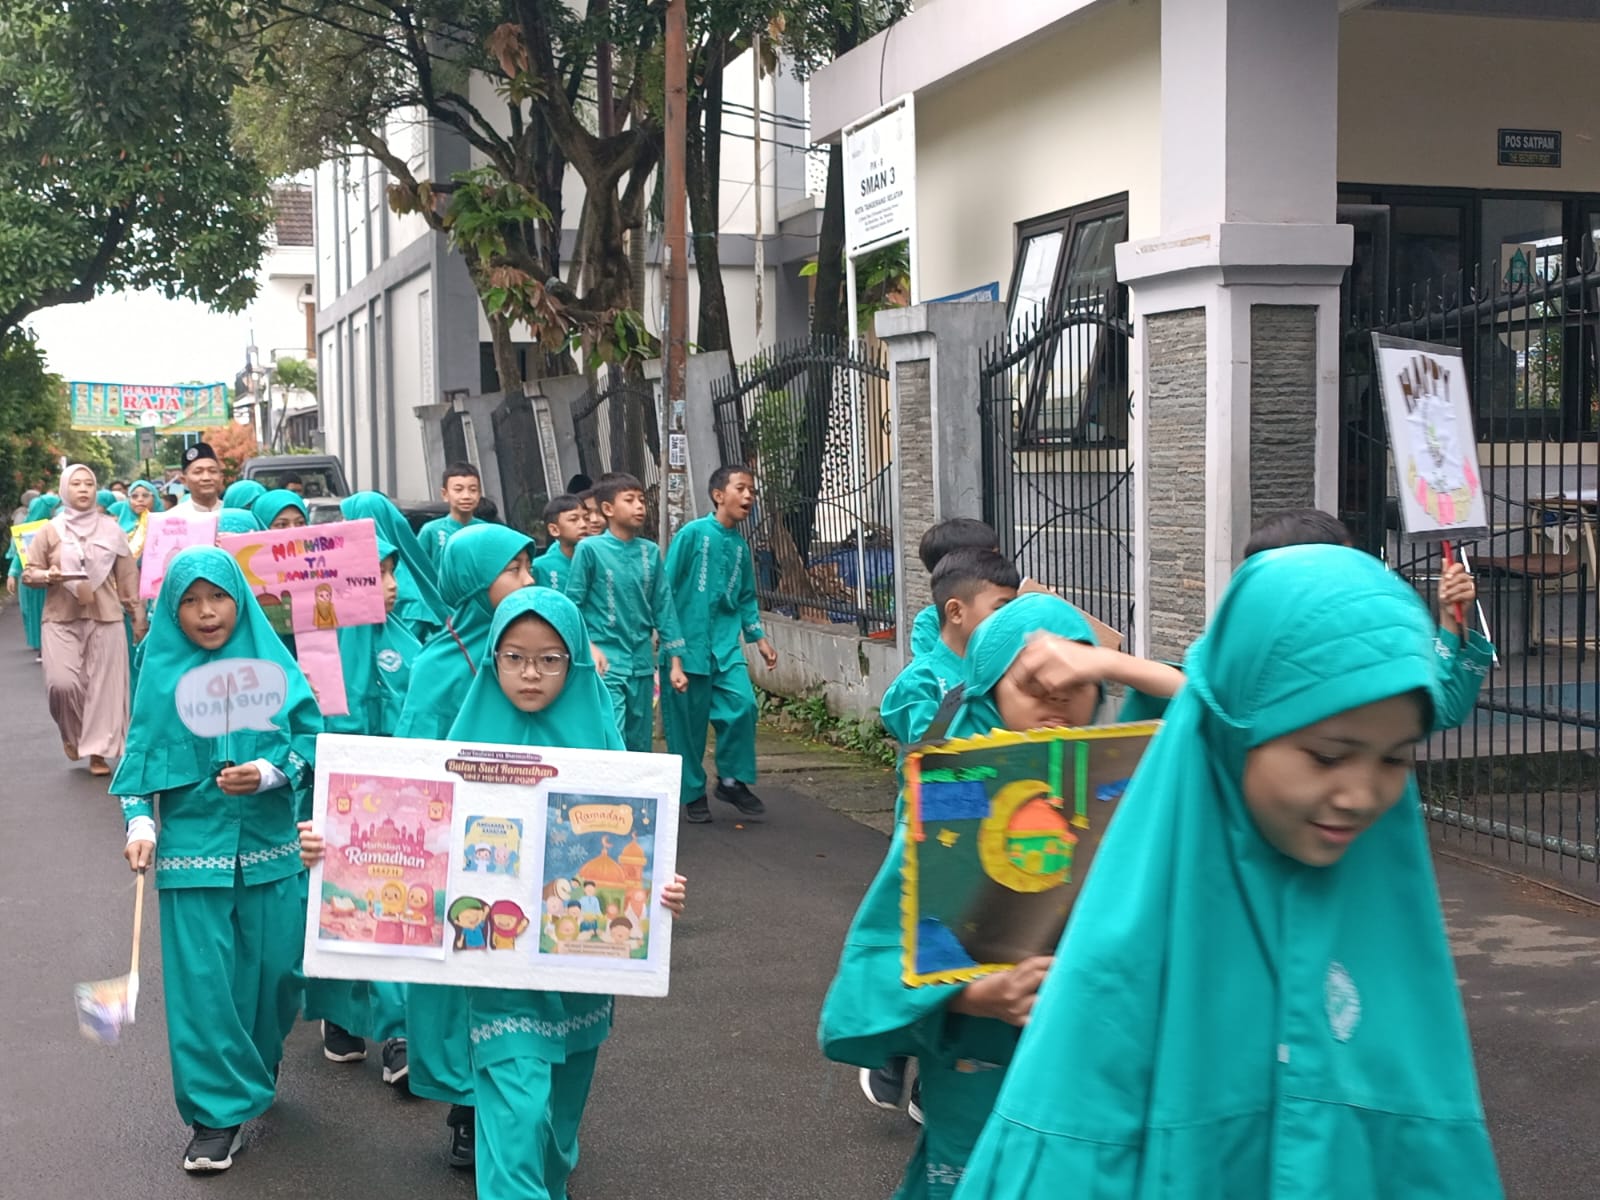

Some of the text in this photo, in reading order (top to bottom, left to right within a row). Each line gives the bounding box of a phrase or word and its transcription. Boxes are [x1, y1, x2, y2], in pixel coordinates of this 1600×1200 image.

[1505, 135, 1554, 149] POS SATPAM
[861, 166, 896, 197] SMAN 3
[123, 396, 181, 411] RAJA
[448, 760, 477, 773] Bulan
[501, 763, 554, 778] Ramadhan
[574, 810, 626, 825] Ramadan
[344, 846, 426, 870] Ramadhan
